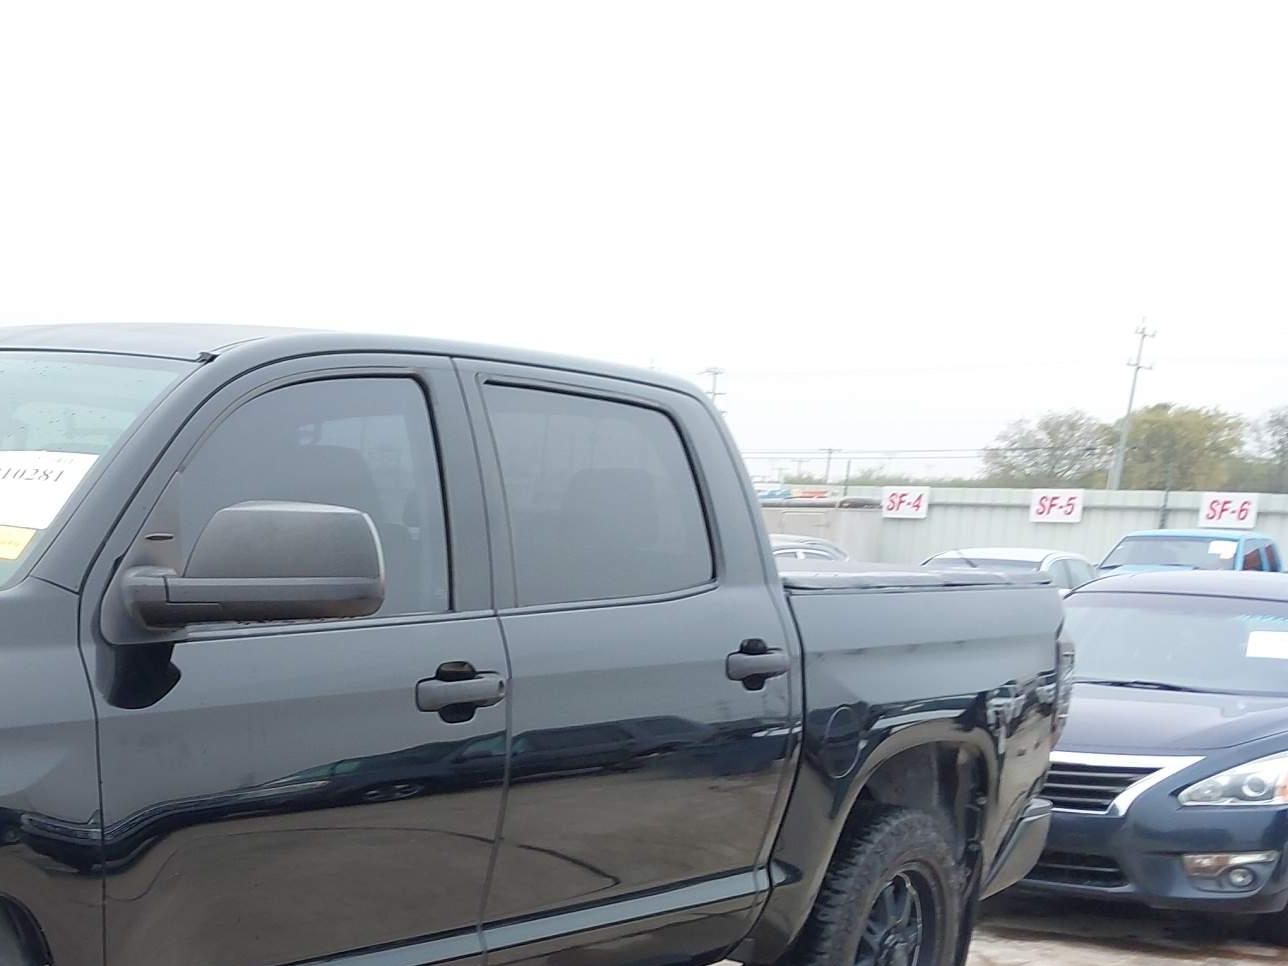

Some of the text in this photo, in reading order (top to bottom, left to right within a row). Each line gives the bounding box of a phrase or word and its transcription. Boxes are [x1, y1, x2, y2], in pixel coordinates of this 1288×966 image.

[885, 493, 923, 512] SF-4
[1035, 495, 1078, 516] SF-5
[1205, 499, 1251, 521] SF-6
